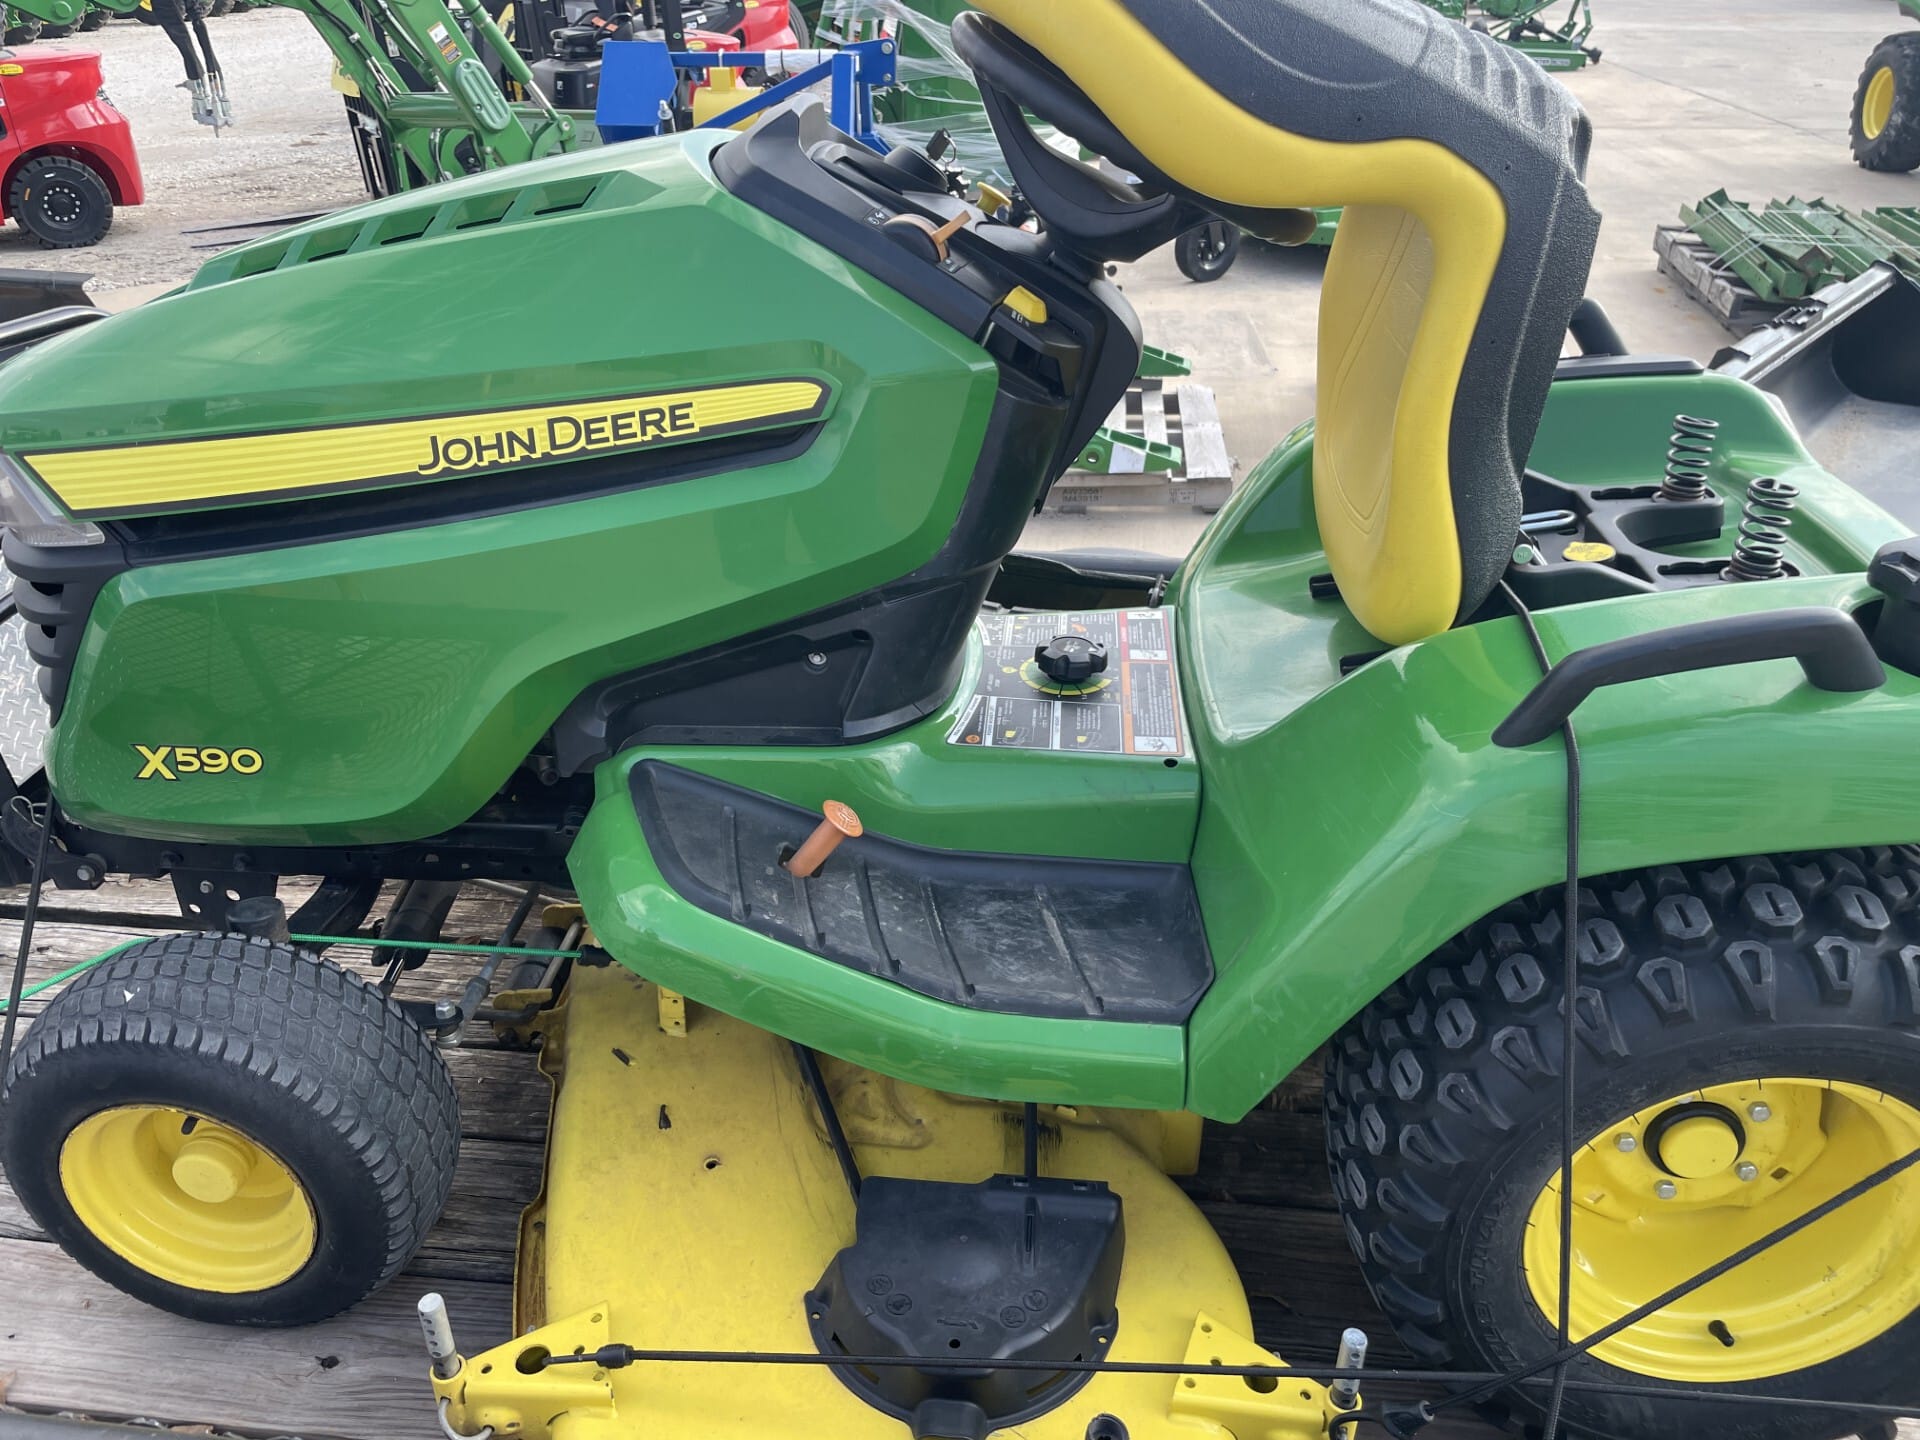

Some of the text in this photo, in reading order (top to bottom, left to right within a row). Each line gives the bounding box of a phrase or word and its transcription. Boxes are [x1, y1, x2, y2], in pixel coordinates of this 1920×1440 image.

[418, 402, 697, 472] JOHN DEERE
[133, 744, 264, 780] X590
